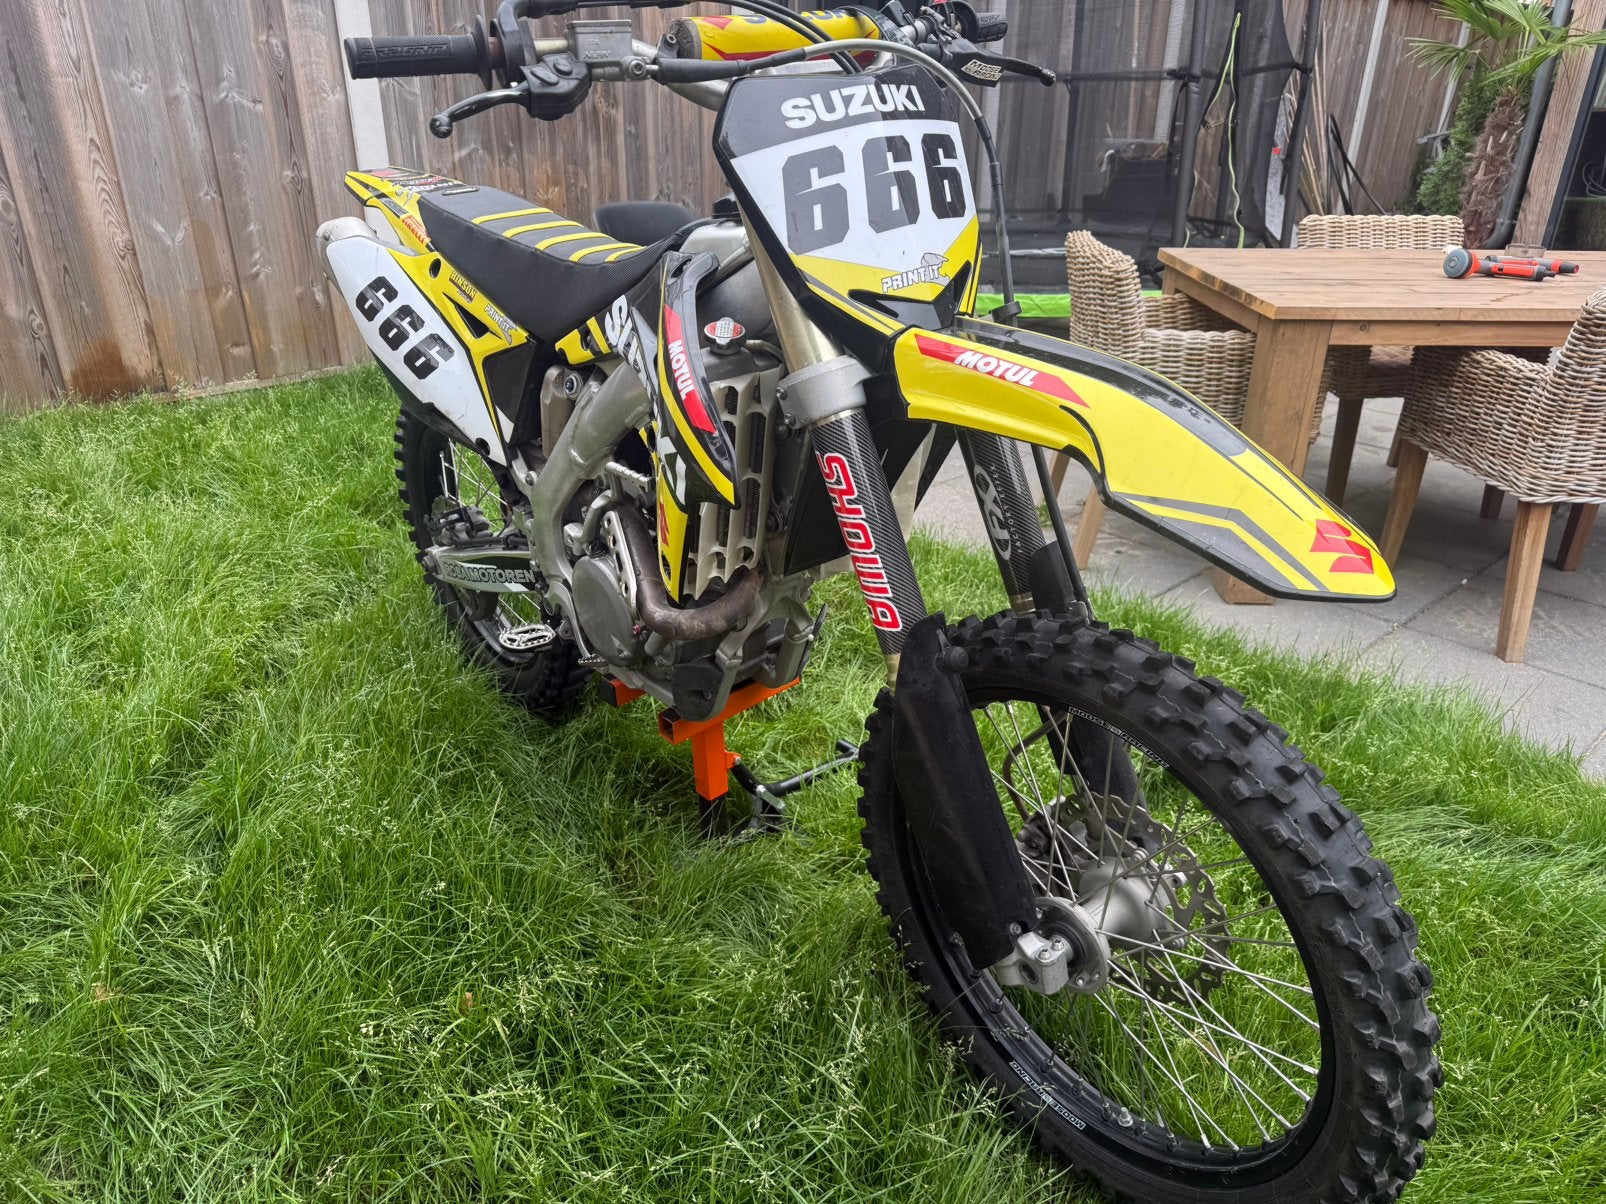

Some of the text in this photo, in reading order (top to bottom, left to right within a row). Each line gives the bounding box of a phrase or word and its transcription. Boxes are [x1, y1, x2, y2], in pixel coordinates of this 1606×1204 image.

[781, 84, 925, 129] SUZUKI
[782, 133, 966, 256] 666
[450, 270, 478, 298] HINSON
[881, 264, 939, 293] PRINT IT
[355, 275, 455, 380] 666
[484, 303, 504, 327] PRINT
[668, 340, 695, 400] MOTUL
[954, 350, 1039, 387] MOTUL
[815, 450, 902, 631] SHOWA
[1050, 1099, 1086, 1130] MOOSE
